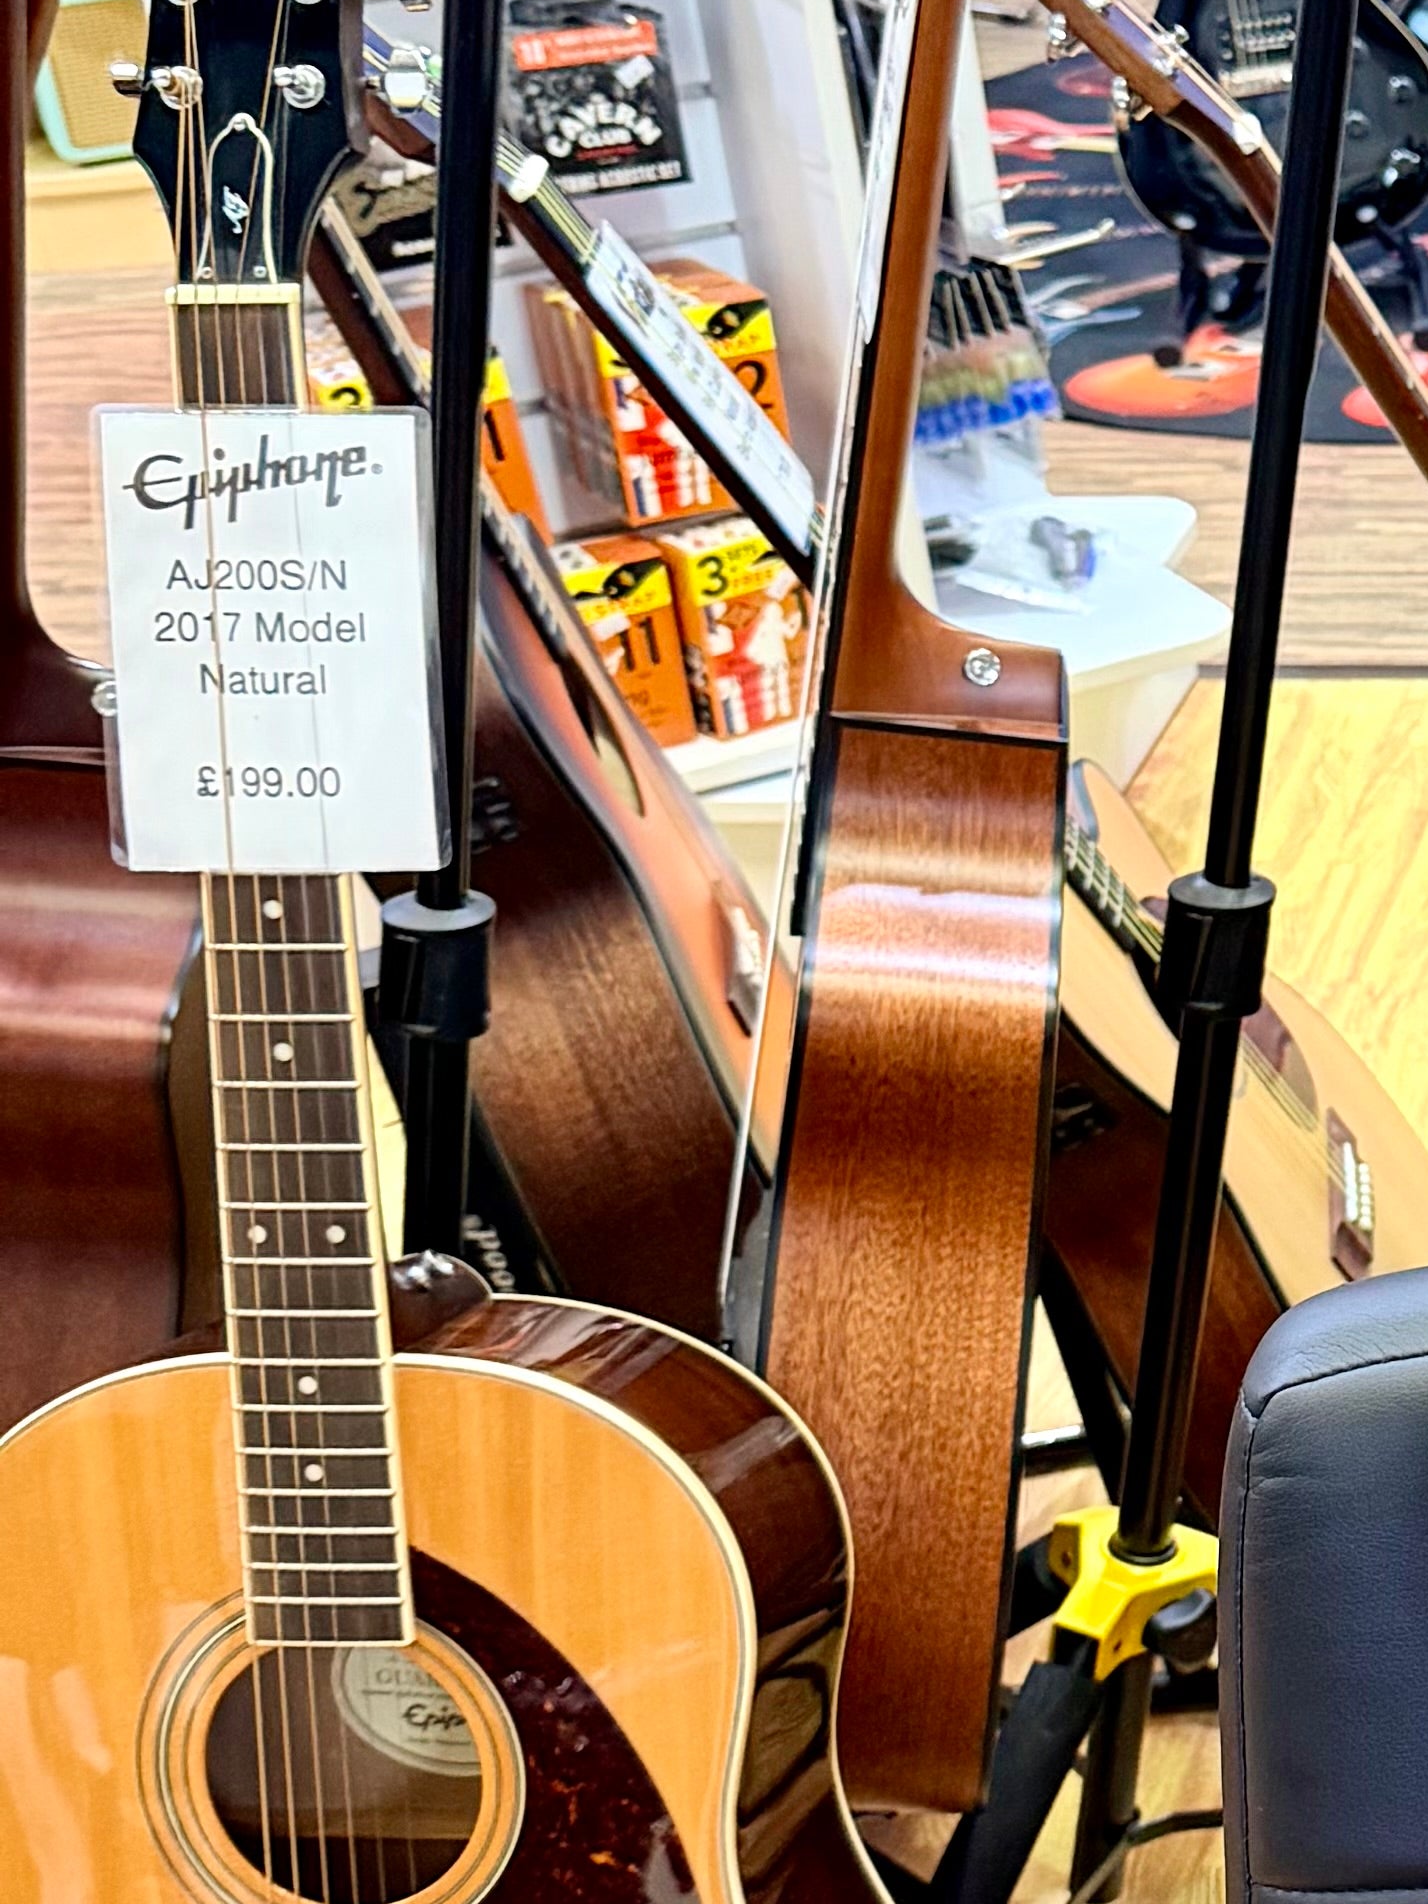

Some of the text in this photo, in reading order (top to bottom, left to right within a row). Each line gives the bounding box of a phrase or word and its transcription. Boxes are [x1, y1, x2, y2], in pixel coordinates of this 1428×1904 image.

[545, 92, 663, 159] CAVERN
[578, 126, 633, 150] CLUB
[122, 434, 368, 530] Epiphone
[167, 559, 347, 592] AJ200S/N
[698, 555, 728, 596] 3
[154, 611, 366, 644] 2017 Model
[200, 664, 326, 696] Natural
[196, 766, 341, 799] £199.00
